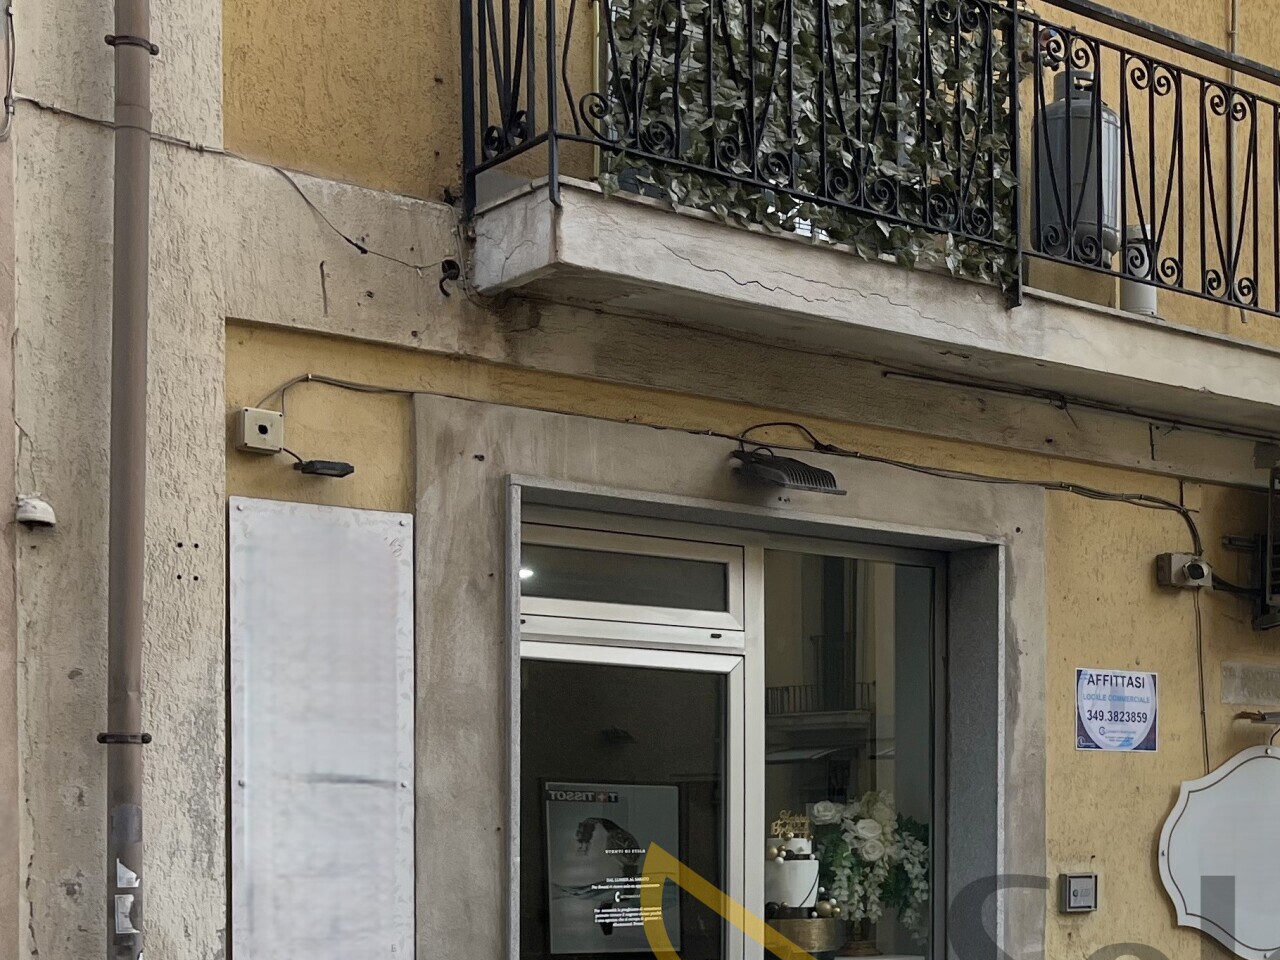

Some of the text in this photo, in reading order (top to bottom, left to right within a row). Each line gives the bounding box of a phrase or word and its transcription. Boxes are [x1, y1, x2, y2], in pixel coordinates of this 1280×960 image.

[1087, 673, 1145, 689] AFFITTASI
[1082, 693, 1151, 704] LOCALE COMMERCIALE
[1087, 709, 1148, 723] 349.3823859
